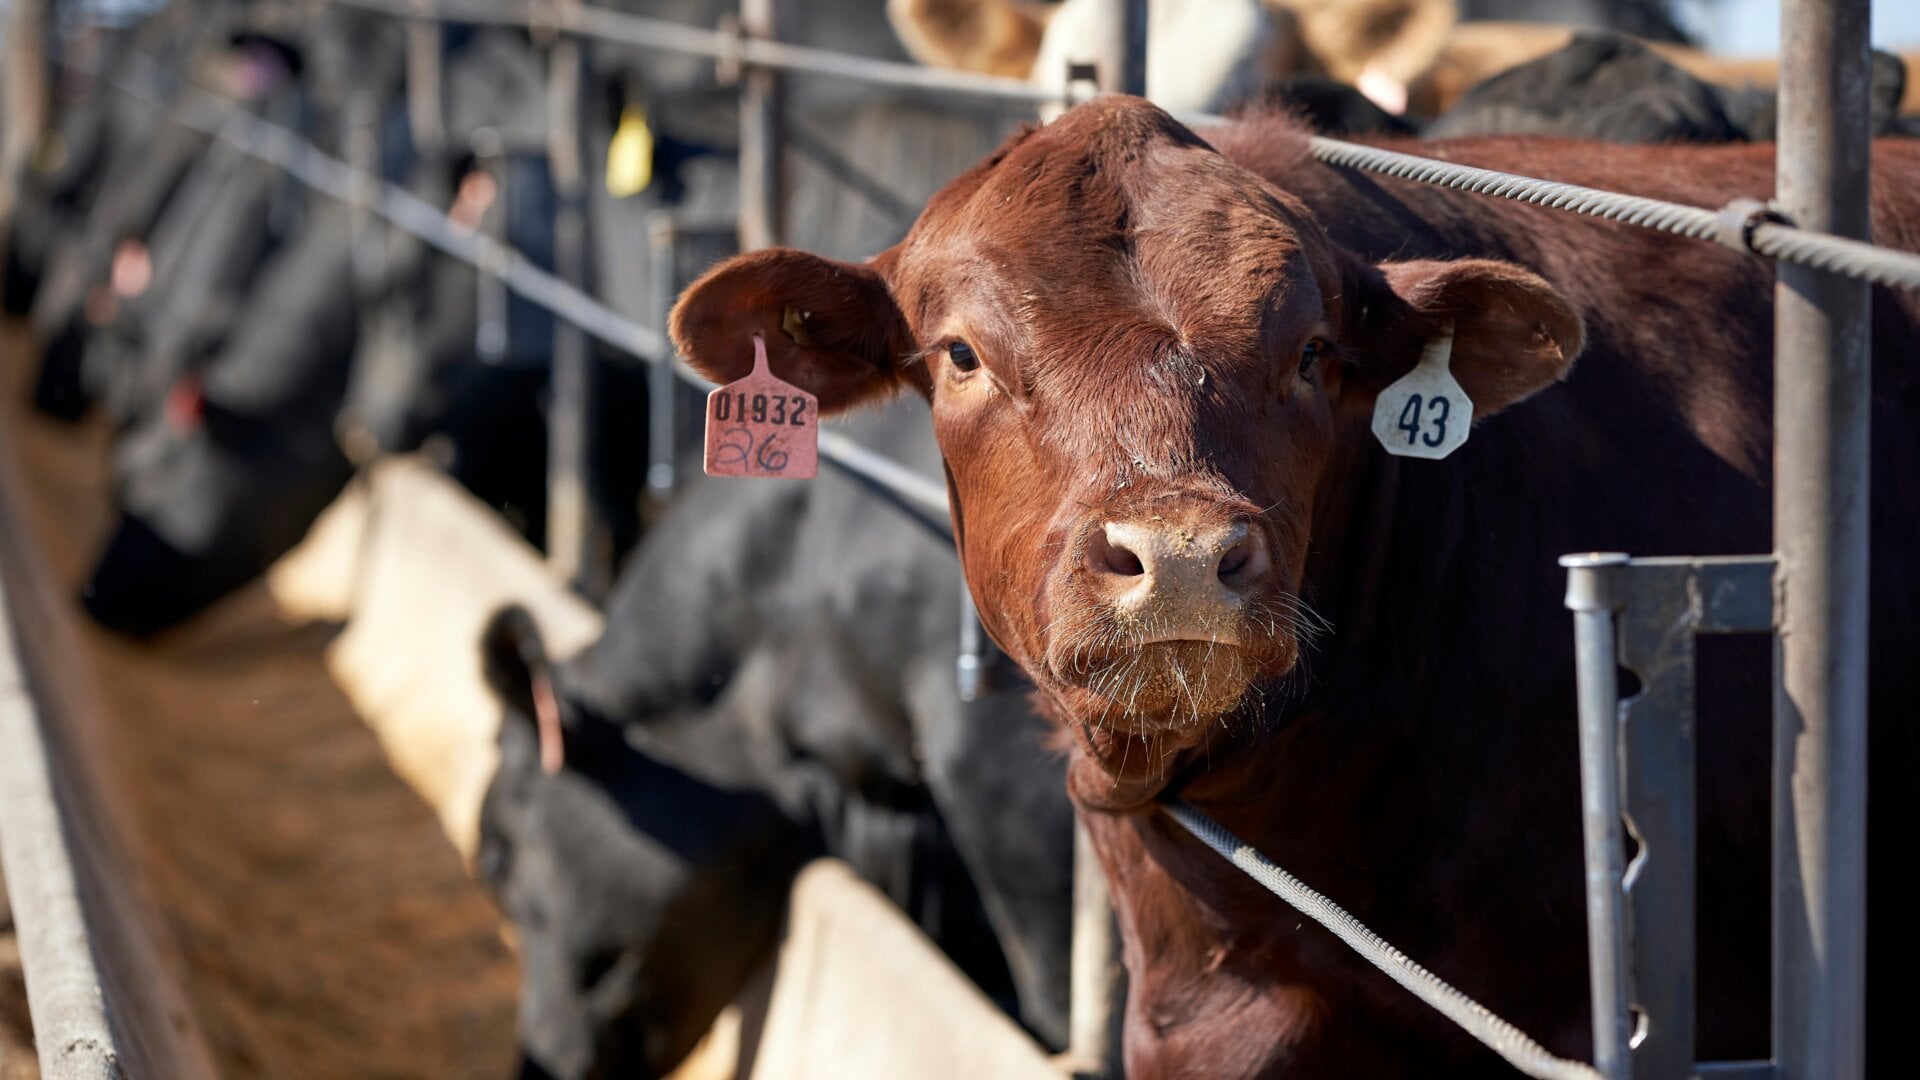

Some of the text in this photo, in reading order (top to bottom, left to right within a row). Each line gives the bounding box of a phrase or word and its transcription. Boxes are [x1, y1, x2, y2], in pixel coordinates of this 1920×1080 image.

[716, 392, 807, 426] 01932
[1399, 393, 1450, 447] 43
[715, 428, 788, 472] 26
